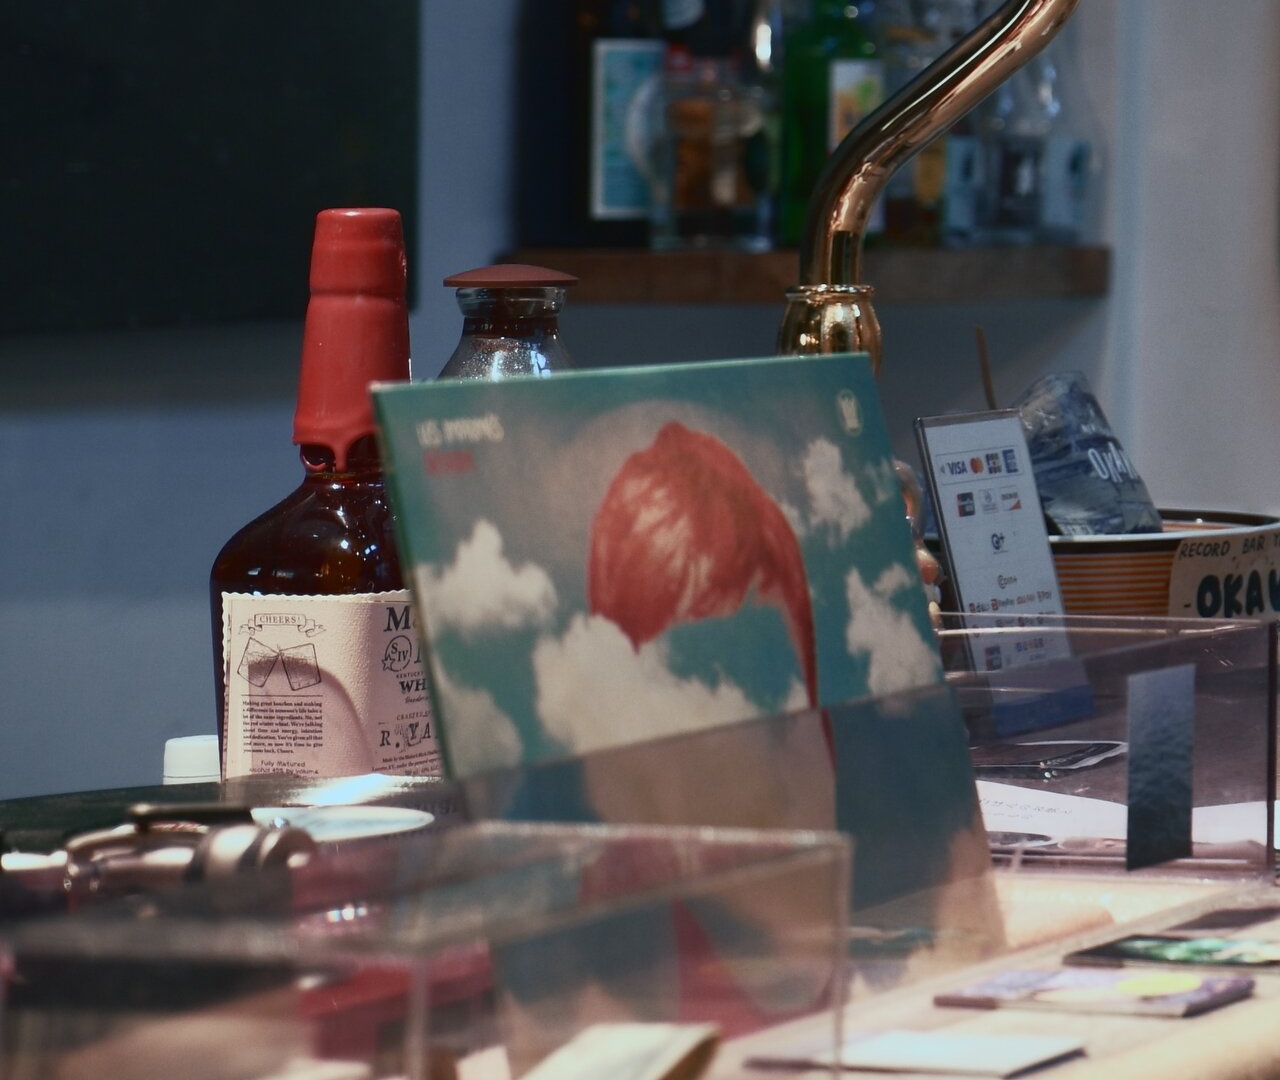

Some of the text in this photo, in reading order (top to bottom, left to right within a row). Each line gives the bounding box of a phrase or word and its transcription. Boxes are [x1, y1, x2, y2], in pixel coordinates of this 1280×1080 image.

[947, 461, 968, 476] VISA
[1179, 540, 1231, 561] RECORD
[1241, 535, 1265, 555] BAR
[260, 616, 301, 624] CHEERS!
